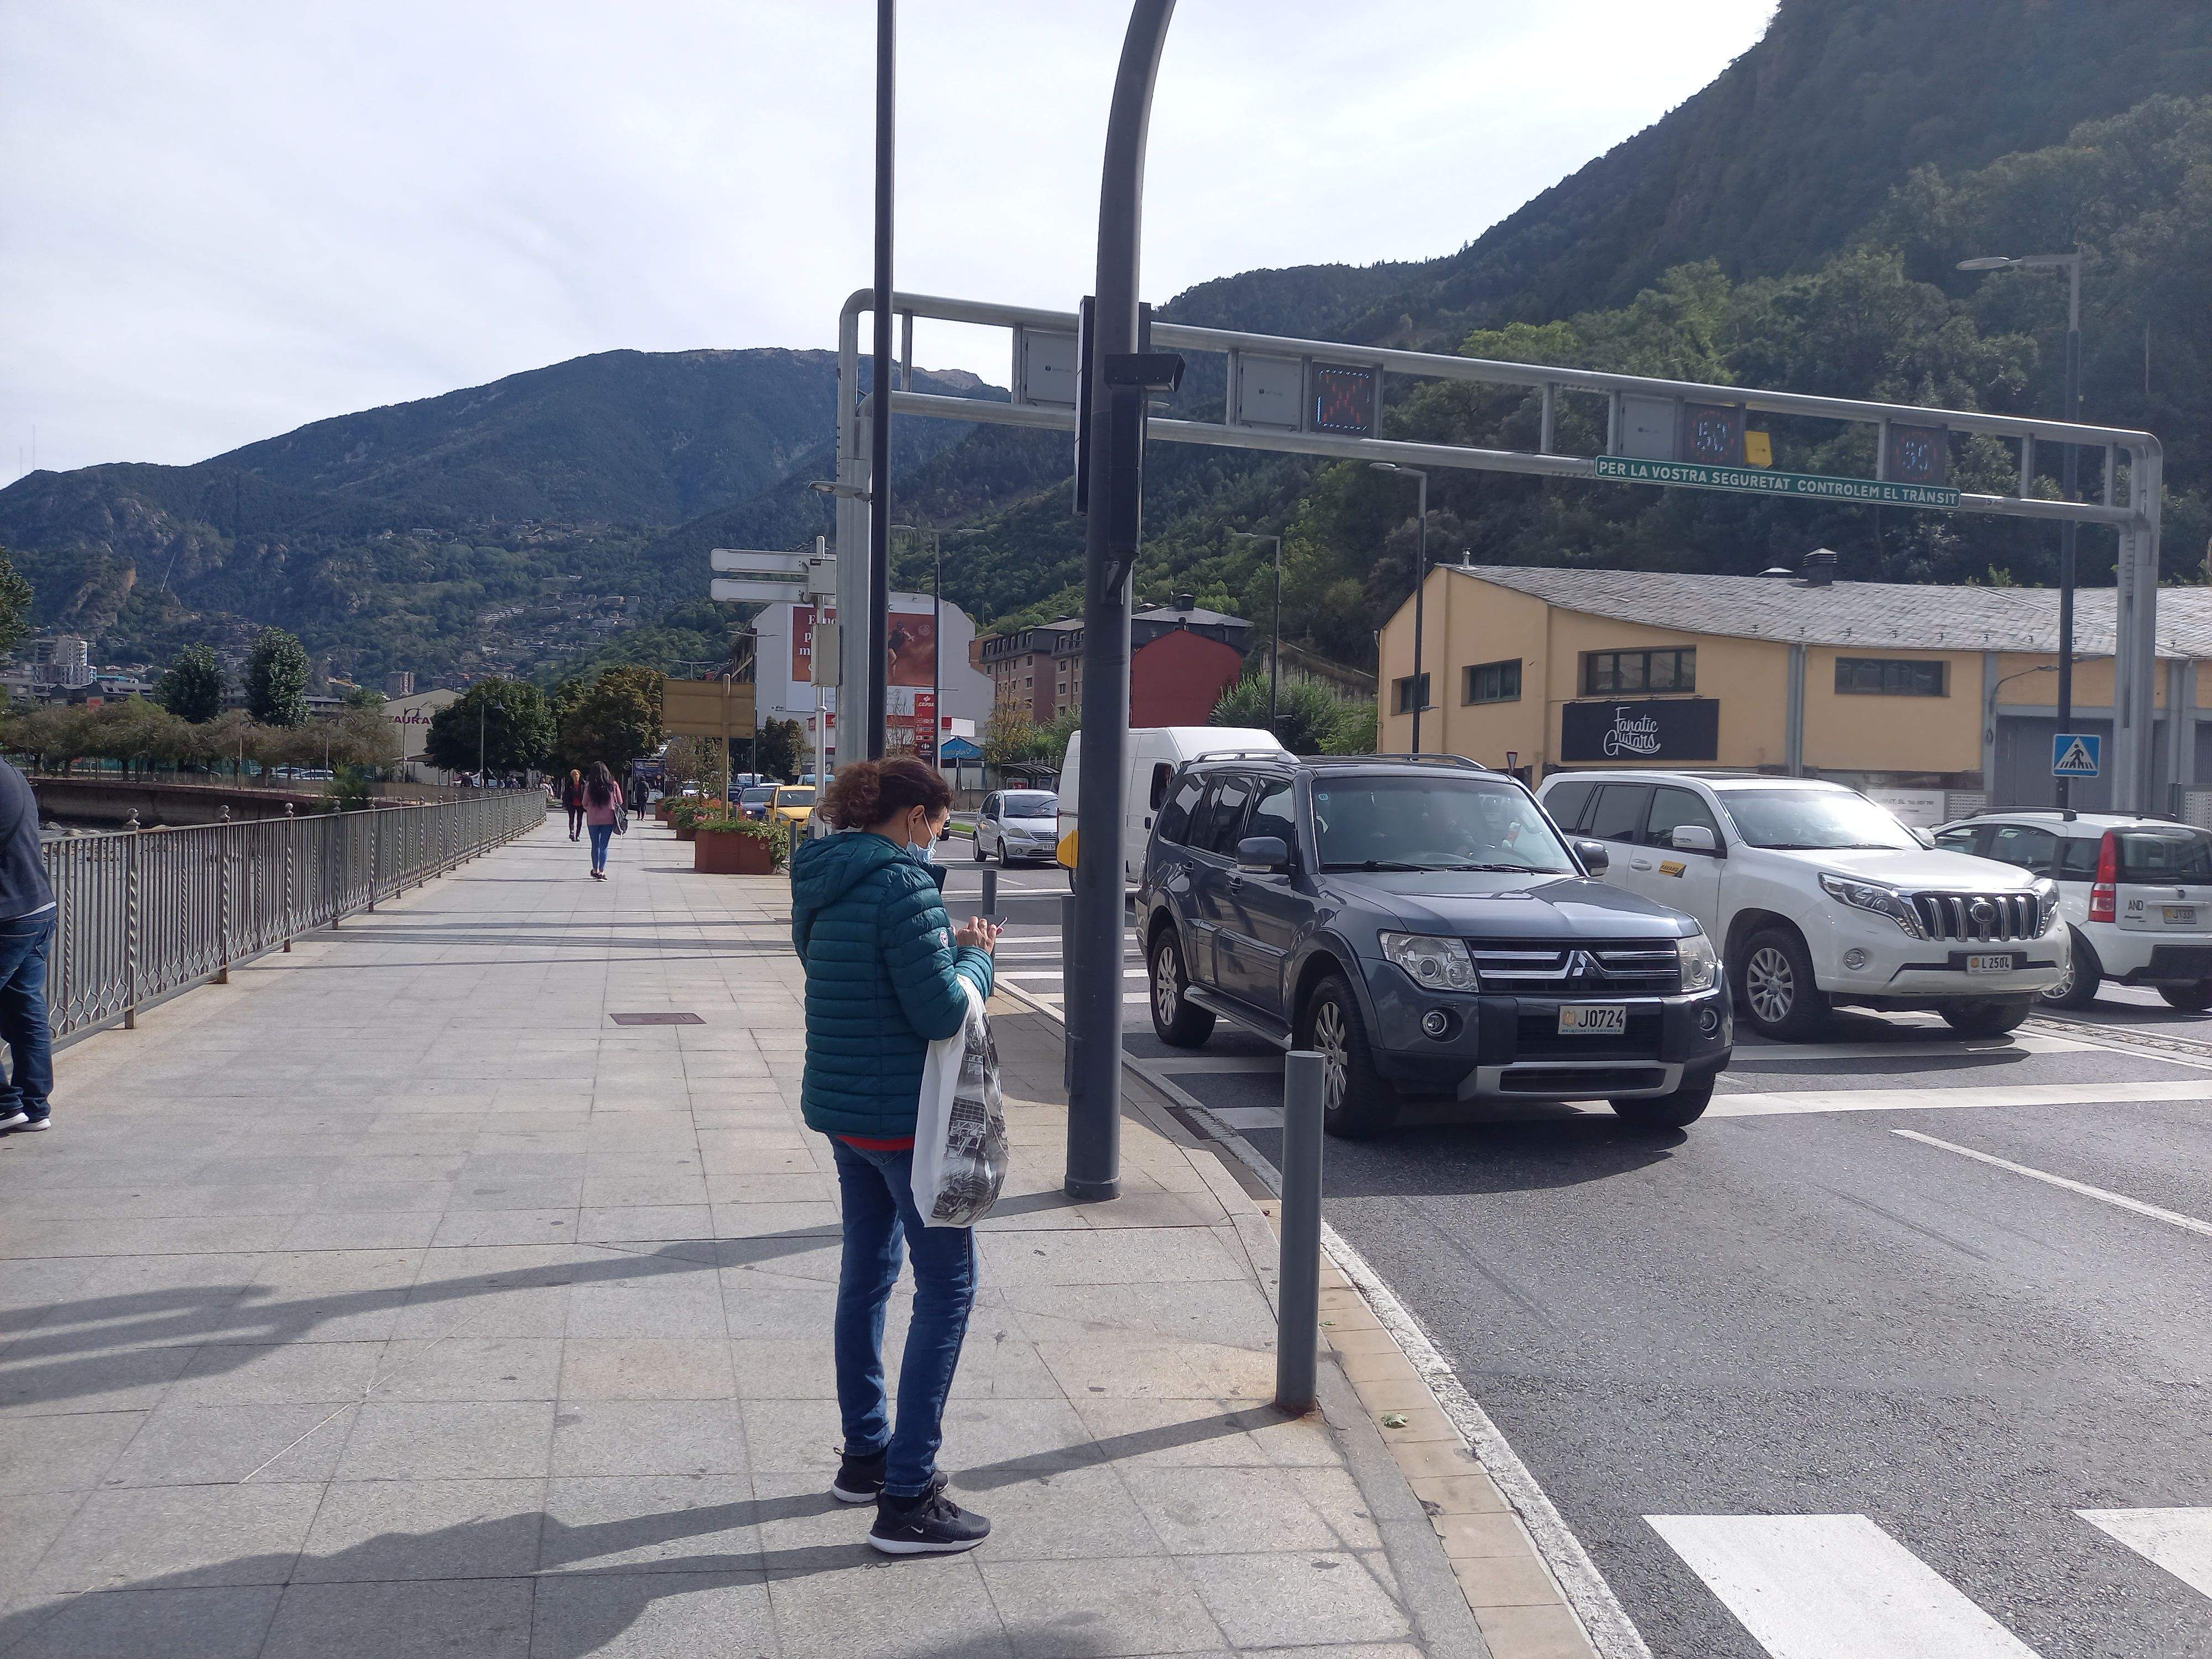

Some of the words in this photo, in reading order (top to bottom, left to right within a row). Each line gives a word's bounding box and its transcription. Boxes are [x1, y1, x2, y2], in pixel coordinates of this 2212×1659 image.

[1599, 461, 1626, 476] PER
[1631, 464, 1648, 477] LA
[1652, 466, 1707, 483] VOSTRA
[1711, 471, 1791, 491] SEGURETAT
[1797, 479, 1879, 498] CONTROLEM
[1884, 487, 1898, 500] EL
[1902, 487, 1957, 504] TRÀNSIT
[394, 716, 431, 724] AURA
[1613, 706, 1658, 734] Fanatic
[1603, 729, 1661, 756] Guitars
[2128, 899, 2143, 911] AND
[1578, 1009, 1624, 1028] J0724
